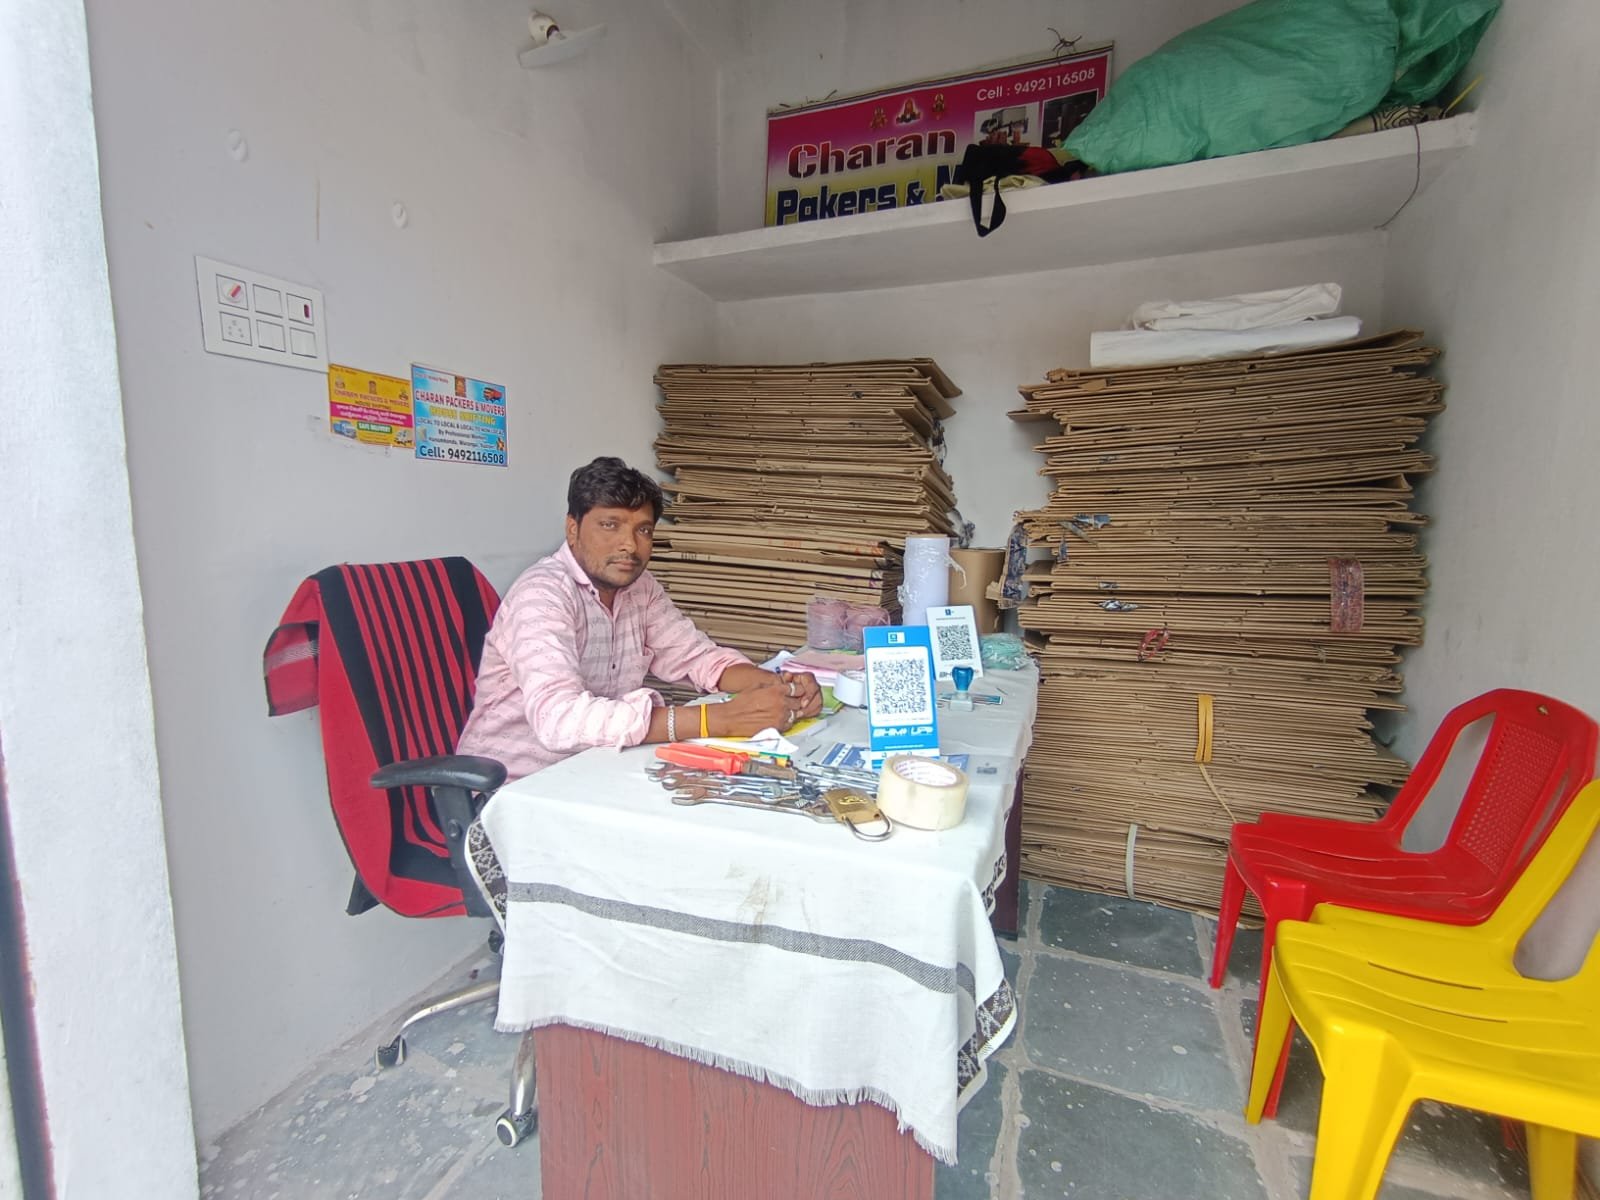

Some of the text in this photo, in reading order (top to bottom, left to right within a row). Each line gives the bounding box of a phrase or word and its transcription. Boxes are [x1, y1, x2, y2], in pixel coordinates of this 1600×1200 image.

[976, 86, 1003, 101] Cell
[1014, 68, 1096, 95] 9492116508
[787, 129, 957, 179] Charan
[775, 184, 898, 226] Pakers
[906, 181, 926, 207] &
[420, 445, 504, 464] Cell: 9492116508
